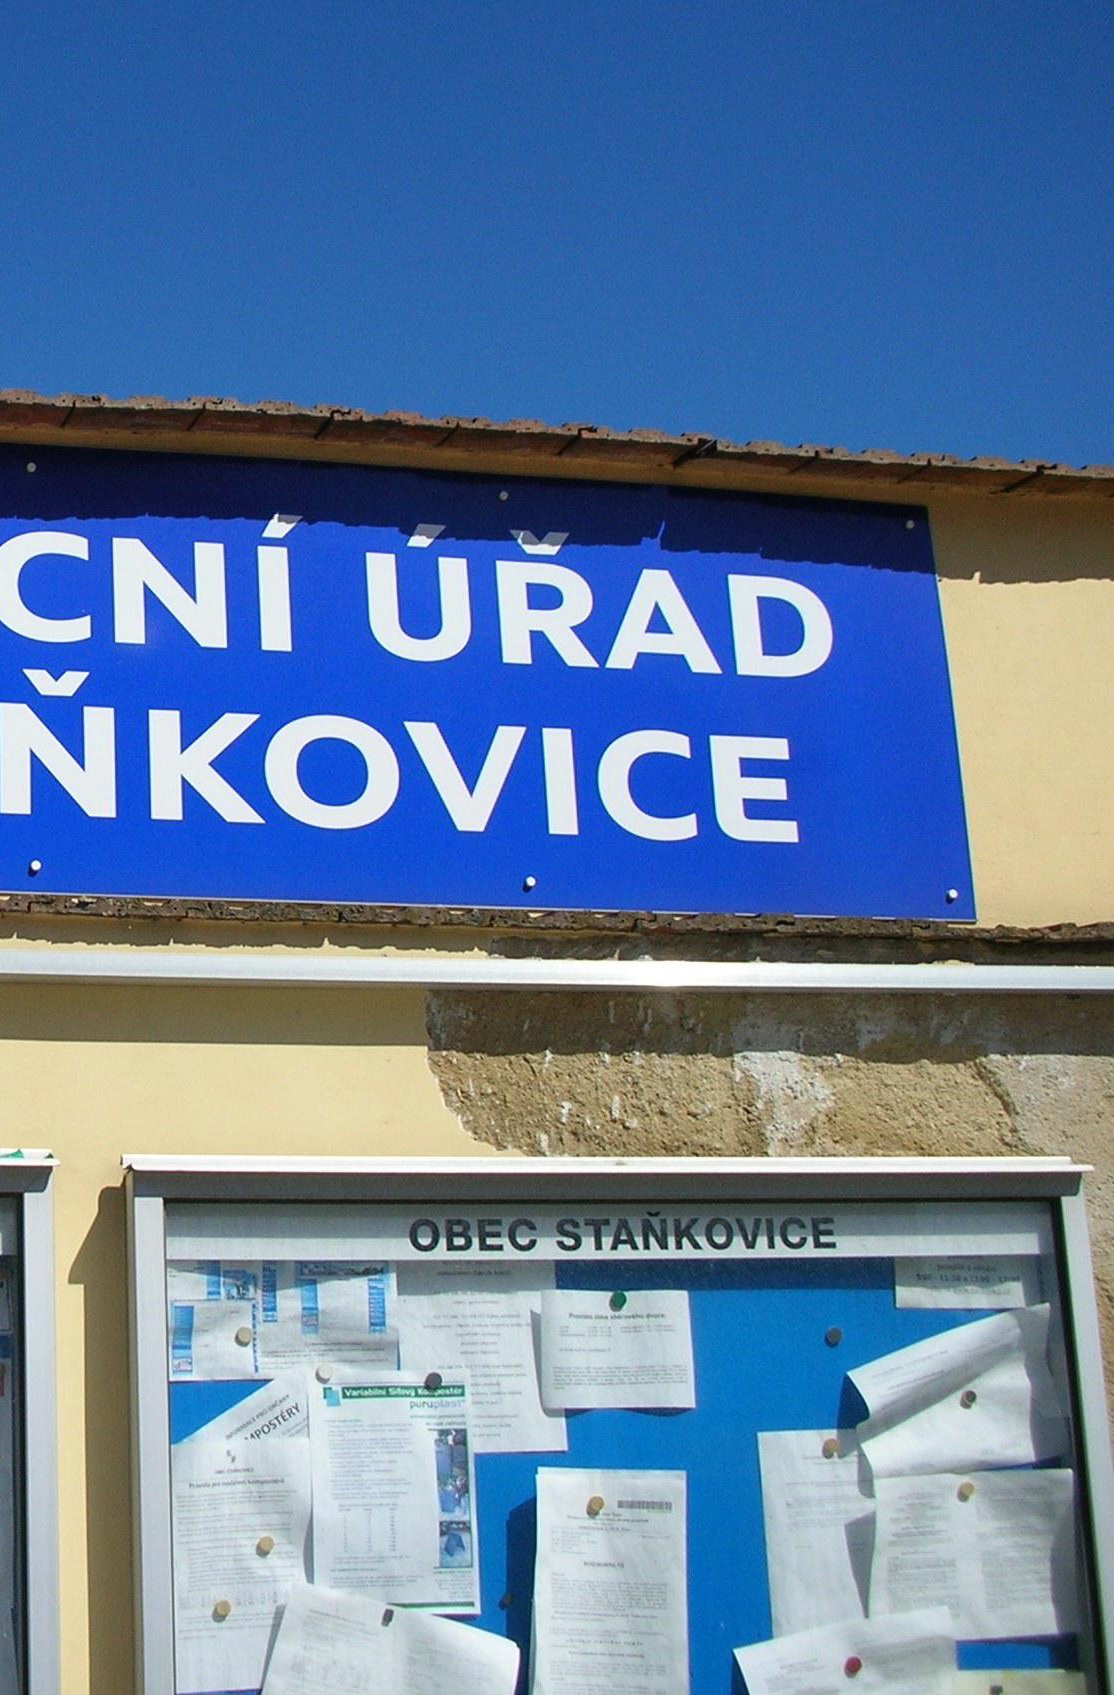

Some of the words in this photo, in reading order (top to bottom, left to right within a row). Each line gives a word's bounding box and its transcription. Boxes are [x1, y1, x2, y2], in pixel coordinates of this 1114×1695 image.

[365, 523, 834, 678] ÚŘAD
[408, 1217, 538, 1252] OBEC
[555, 1211, 837, 1251] STAŇKOVICE
